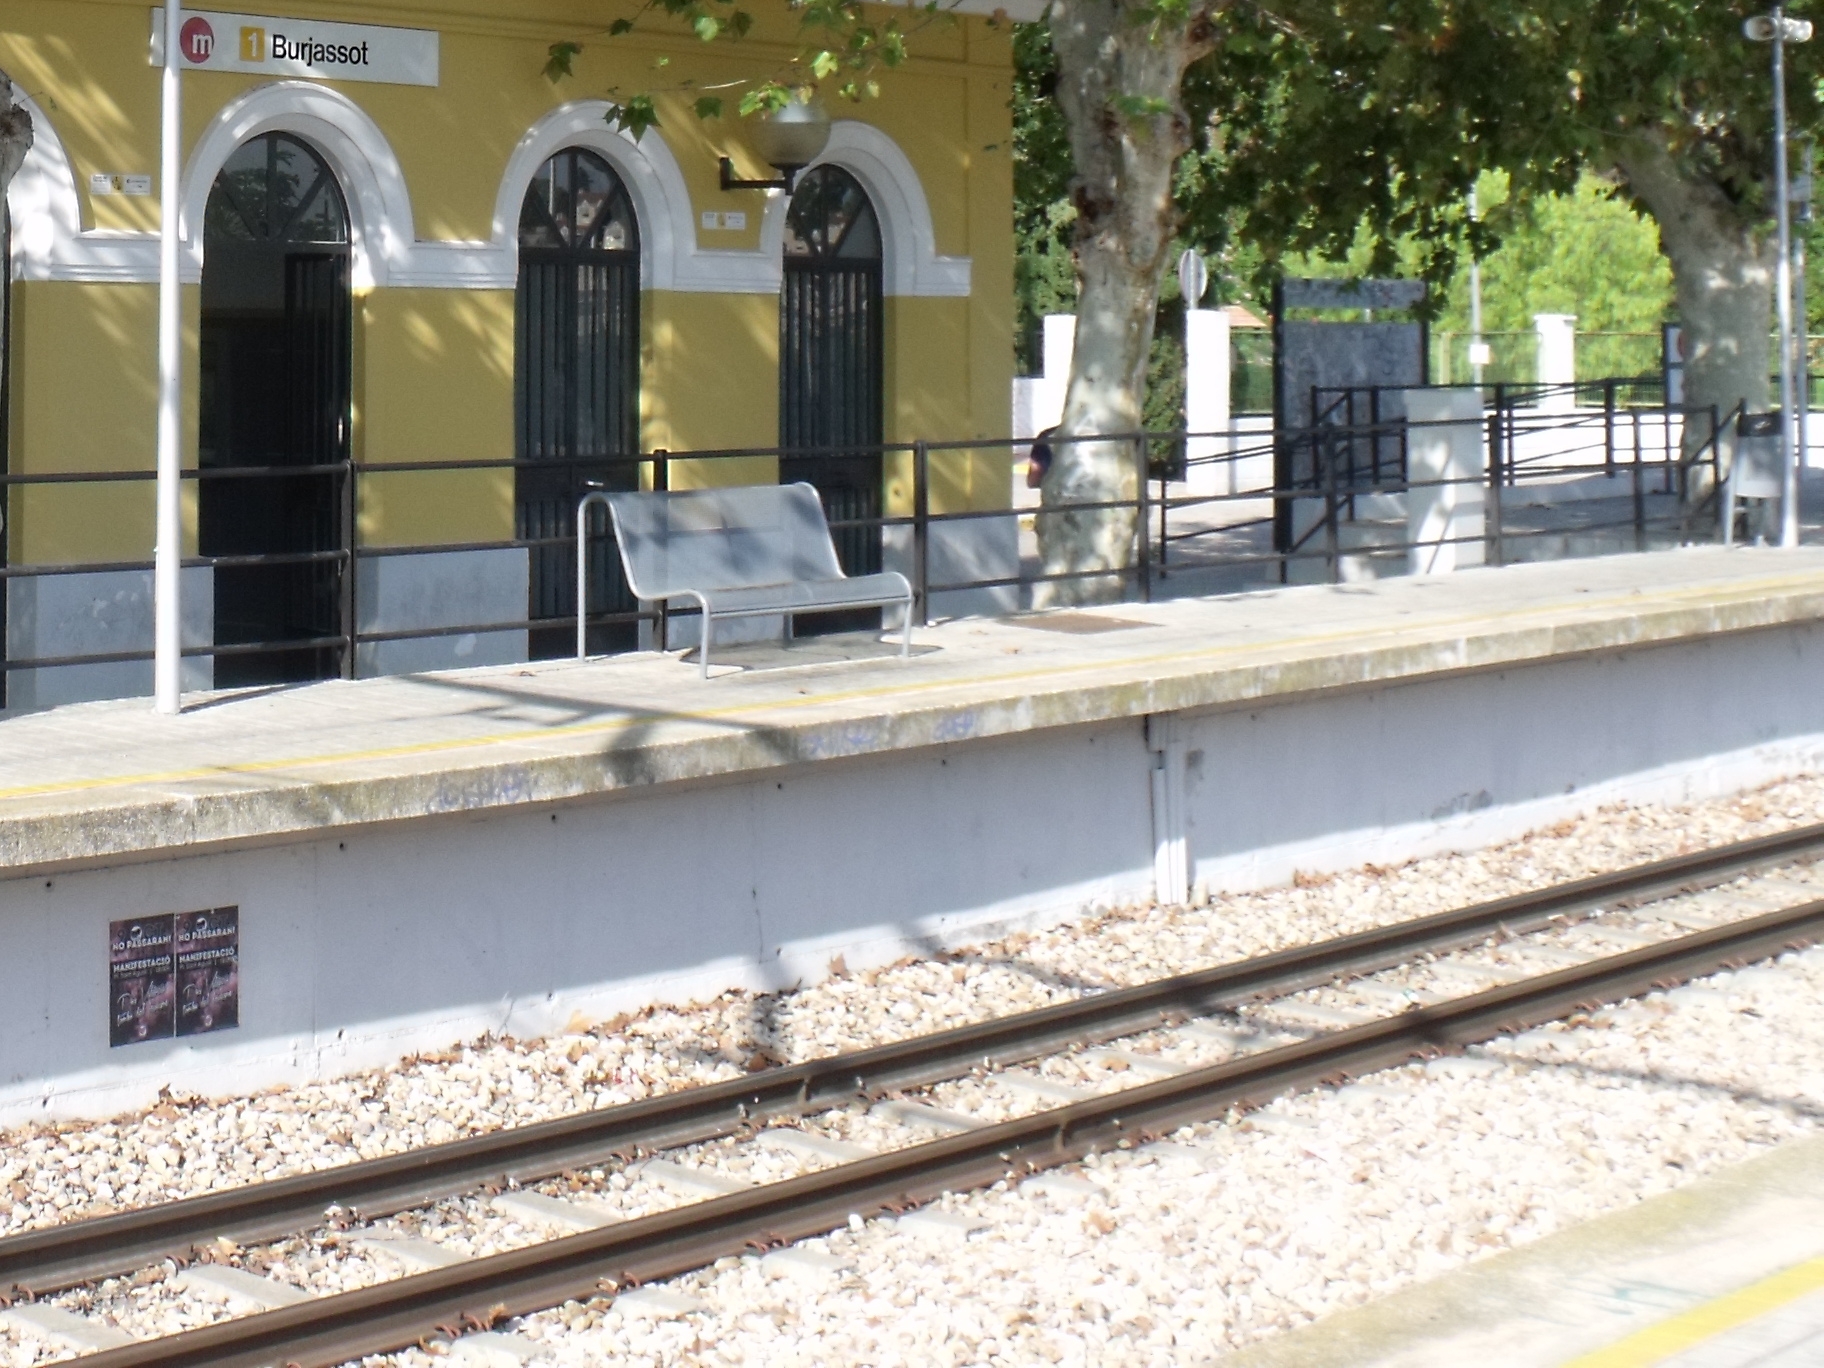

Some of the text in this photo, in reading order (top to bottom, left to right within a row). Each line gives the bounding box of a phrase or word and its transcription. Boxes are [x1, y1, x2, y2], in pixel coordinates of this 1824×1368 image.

[191, 33, 213, 55] m
[272, 33, 369, 66] Burjassot
[178, 933, 190, 942] NO
[112, 941, 125, 951] NO
